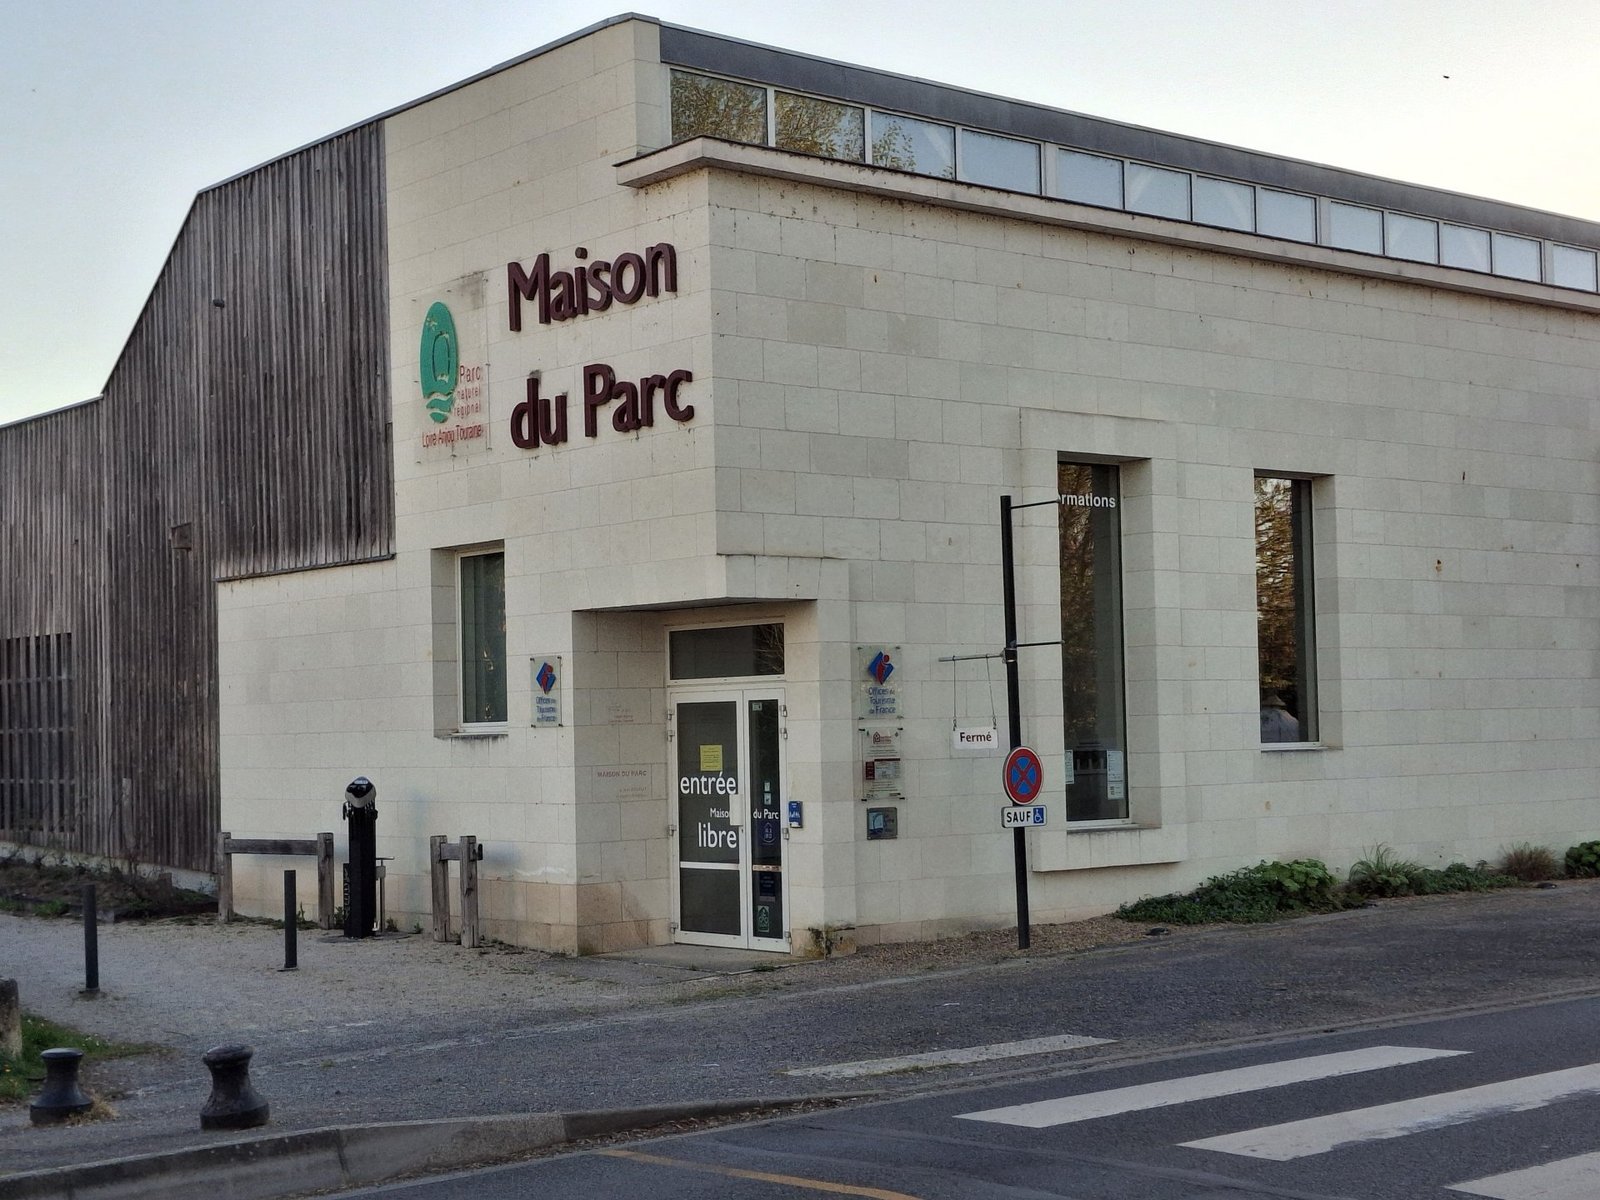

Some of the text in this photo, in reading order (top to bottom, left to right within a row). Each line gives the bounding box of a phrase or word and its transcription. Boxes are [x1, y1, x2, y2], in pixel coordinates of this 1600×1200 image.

[507, 242, 678, 332] Maison
[460, 365, 481, 383] Parc
[510, 363, 695, 449] du Parc
[959, 731, 992, 742] Fermé
[680, 771, 736, 794] entrée
[709, 807, 730, 818] Maiso
[752, 808, 762, 818] du
[763, 808, 779, 820] Parc
[1006, 811, 1031, 823] SAUF
[698, 822, 737, 848] libre
